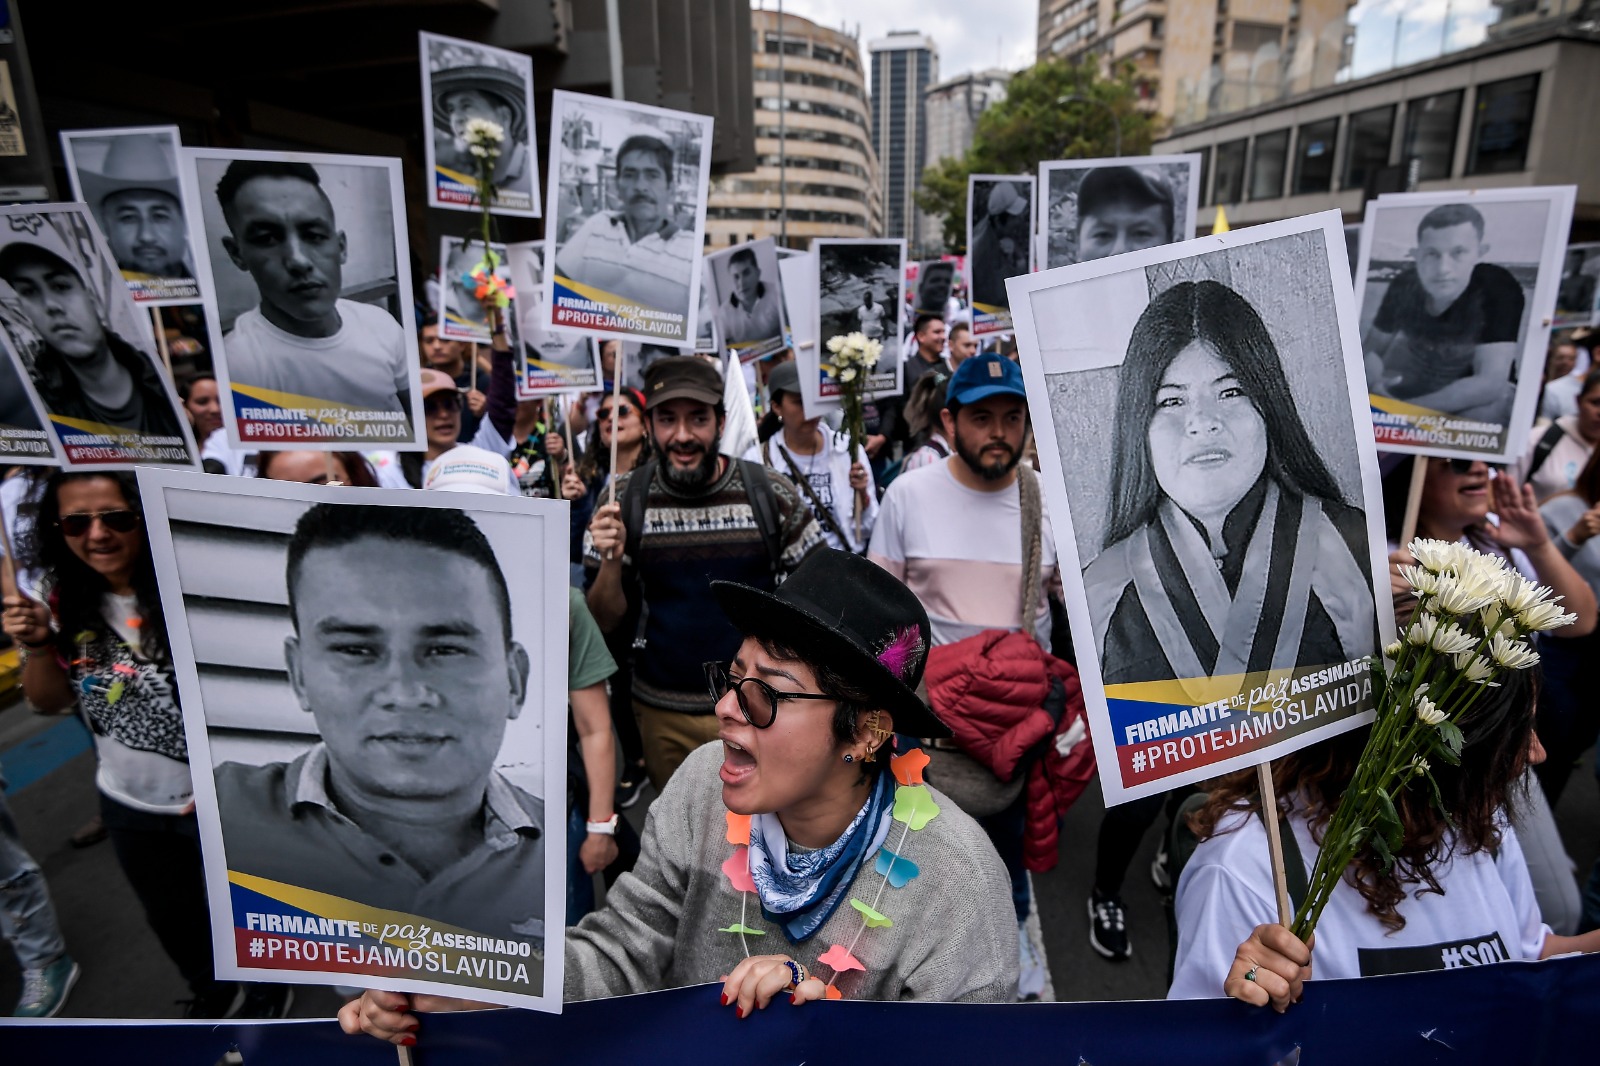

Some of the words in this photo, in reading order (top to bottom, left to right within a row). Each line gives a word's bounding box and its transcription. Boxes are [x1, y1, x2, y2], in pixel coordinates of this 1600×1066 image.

[557, 296, 609, 313] FIRMANTE
[616, 304, 640, 319] paz
[639, 309, 683, 322] ASESINADO
[557, 309, 682, 335] #PROTEJAMOSLAVIDA
[241, 407, 308, 421] FIRMANTE
[317, 407, 348, 424] paz
[348, 410, 406, 421] ASESINADO
[1371, 412, 1408, 425] MANTE
[1415, 414, 1446, 431] paz
[1444, 420, 1502, 433] ASESINADO
[64, 434, 115, 446] FIRMANTE
[141, 436, 184, 446] ASESINADO
[245, 423, 408, 437] #PROTEJAMOSLAVIDA
[1374, 426, 1499, 449] OTEJAMOSLAVIDA
[71, 447, 190, 460] #PROTEJAMOSLAVIDA
[1125, 699, 1231, 745] FIRMANTE
[1231, 693, 1246, 708] DE
[1246, 677, 1291, 716] paz
[1290, 655, 1372, 697] ASESINADO
[1132, 678, 1372, 774] #PROTEJAMOSLAVIDA
[246, 912, 362, 938] FIRMANTE
[363, 922, 378, 934] DE
[378, 923, 432, 949] paz
[431, 931, 531, 957] ASESINADO
[249, 937, 530, 985] #PROTEJAMOSLAVIDA
